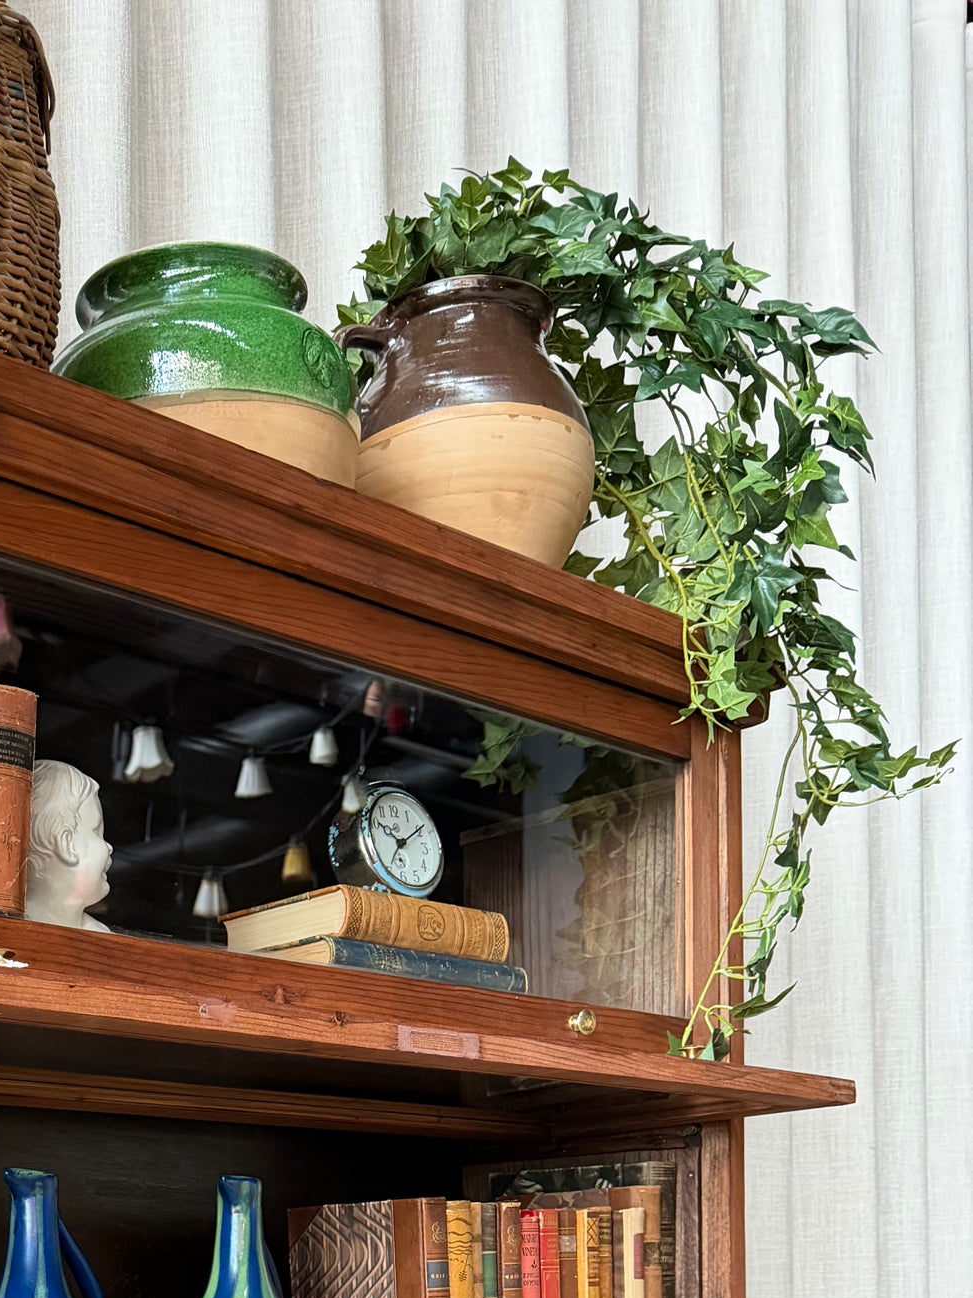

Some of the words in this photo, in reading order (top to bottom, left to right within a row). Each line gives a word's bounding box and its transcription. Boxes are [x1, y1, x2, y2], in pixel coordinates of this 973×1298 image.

[378, 805, 386, 819] 11
[388, 804, 400, 818] 12
[404, 810, 410, 823] 1
[420, 842, 429, 855] 3
[420, 858, 427, 872] 4
[399, 870, 408, 882] 6
[412, 869, 420, 883] 5
